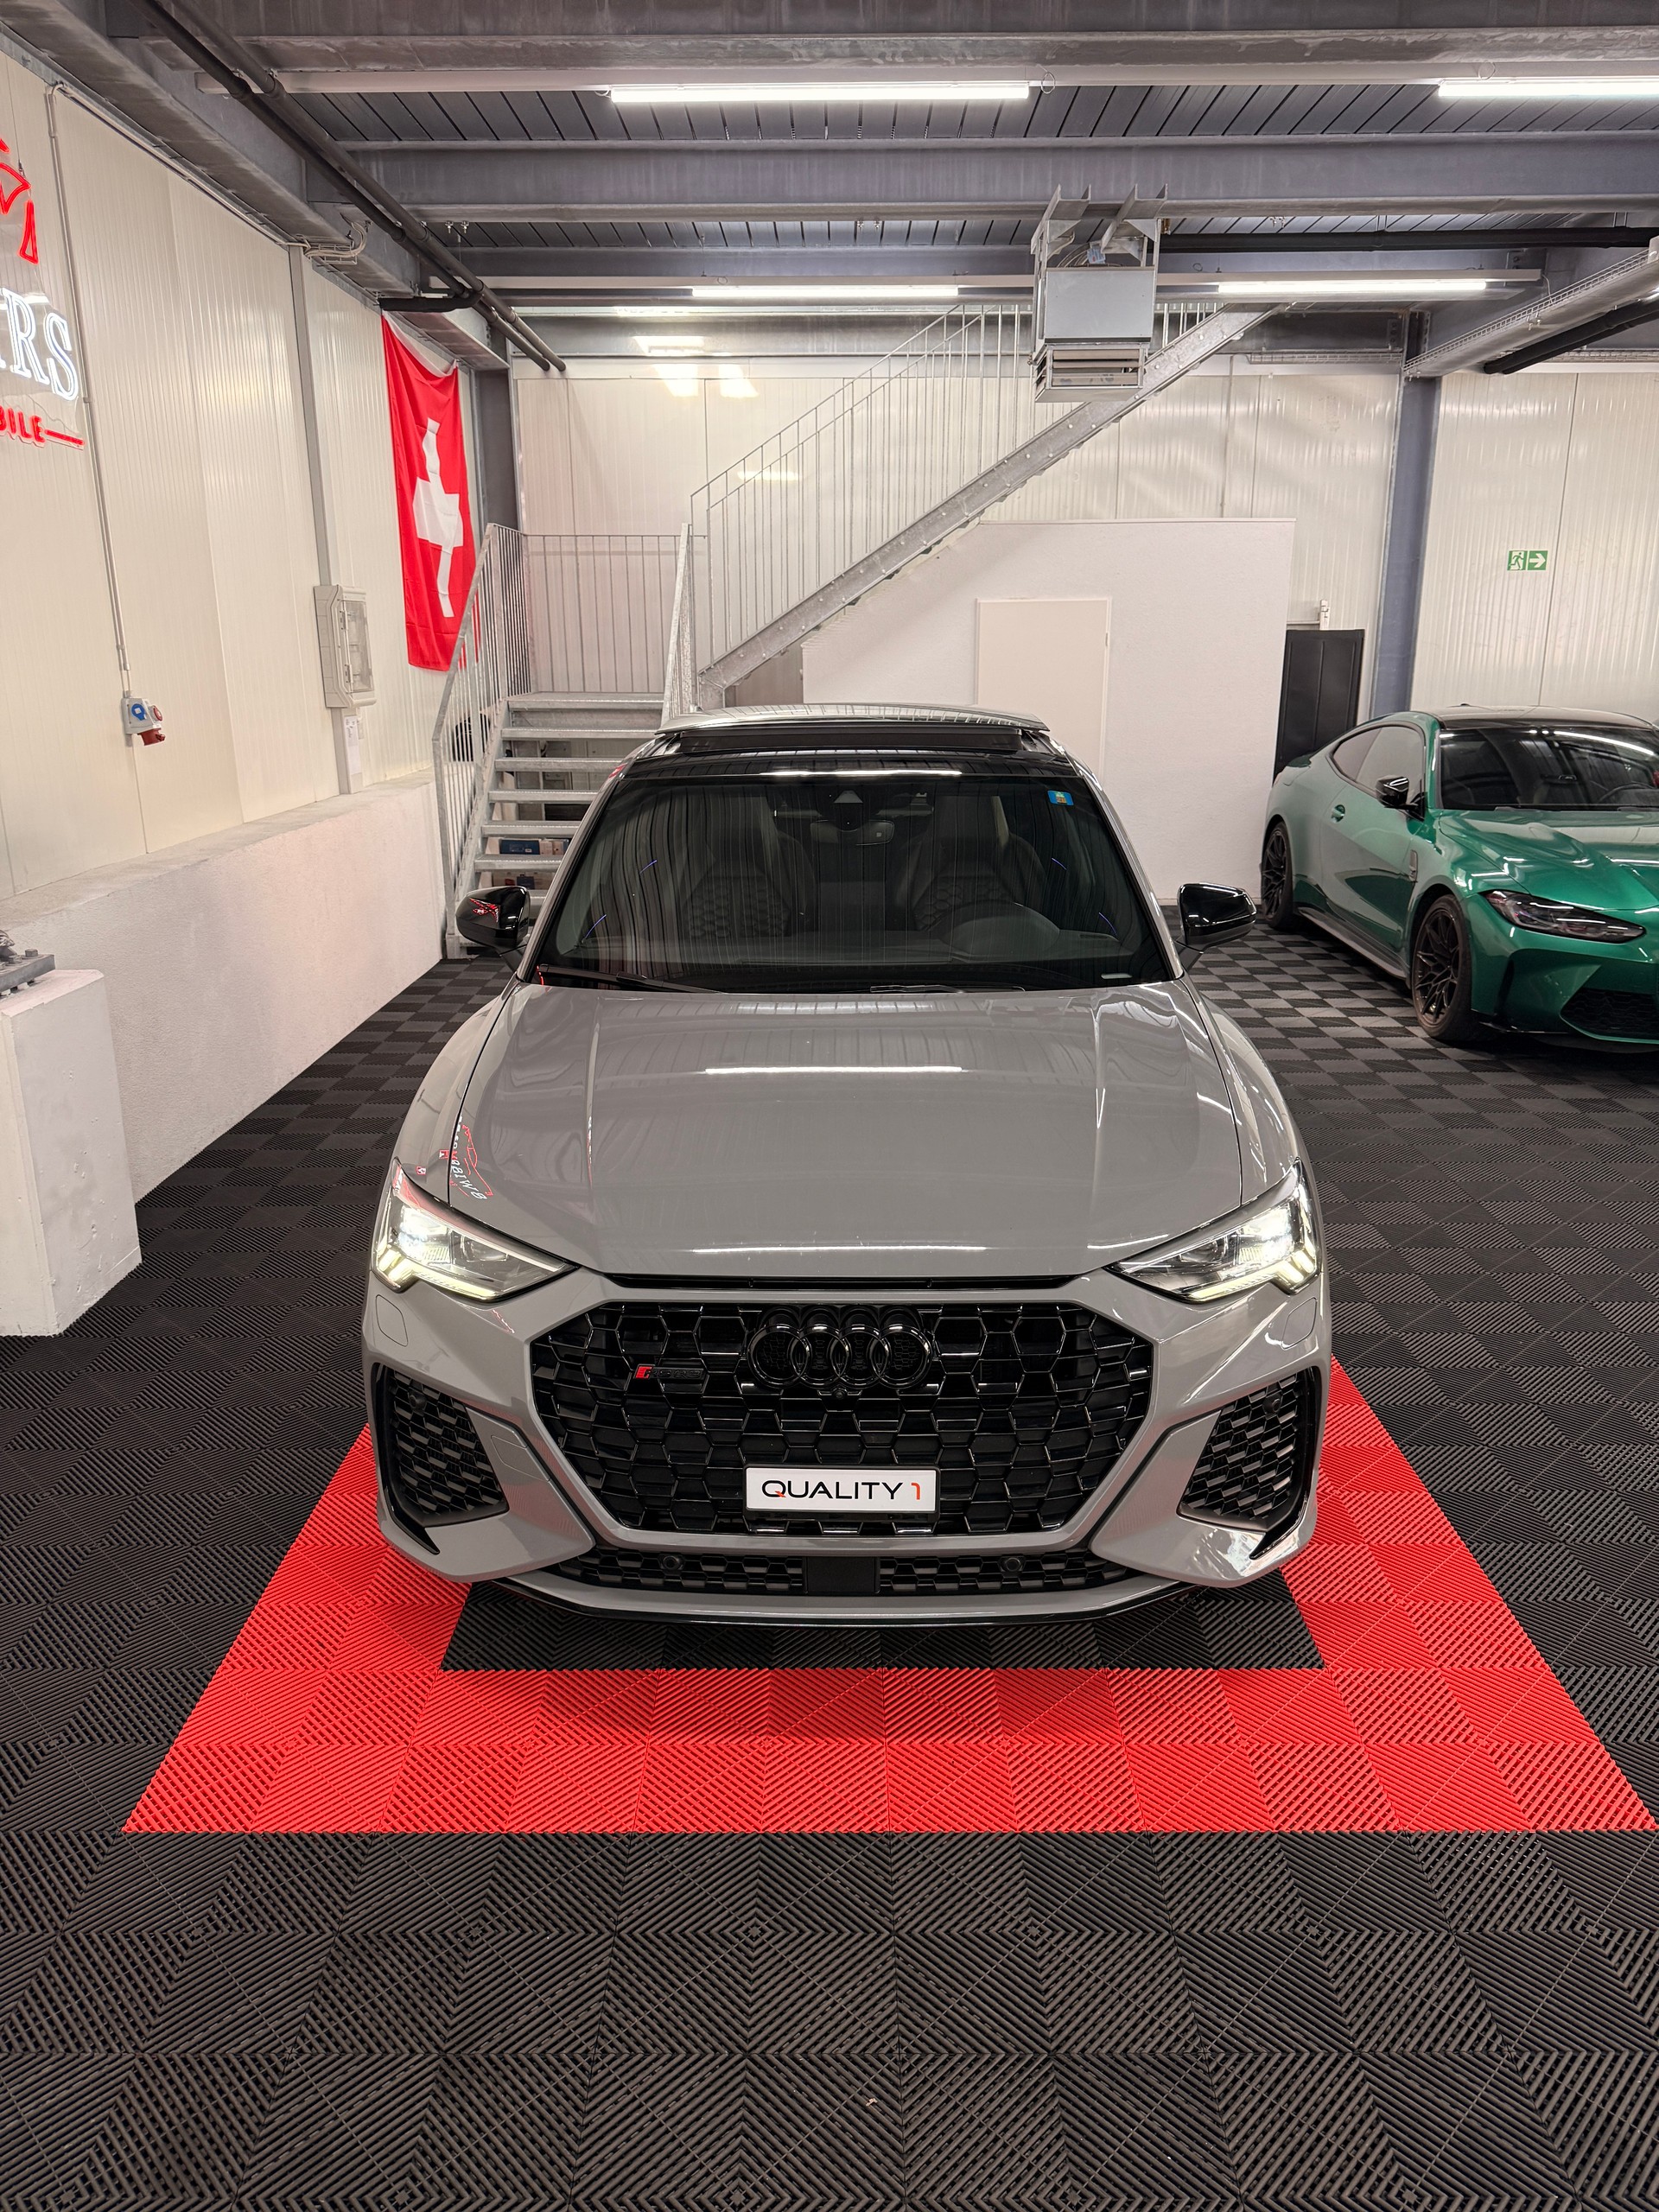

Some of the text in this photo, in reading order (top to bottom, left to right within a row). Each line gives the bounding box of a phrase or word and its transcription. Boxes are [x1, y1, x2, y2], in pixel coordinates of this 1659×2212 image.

[0, 288, 79, 401] RS
[761, 1479, 921, 1501] QUALITY 1
